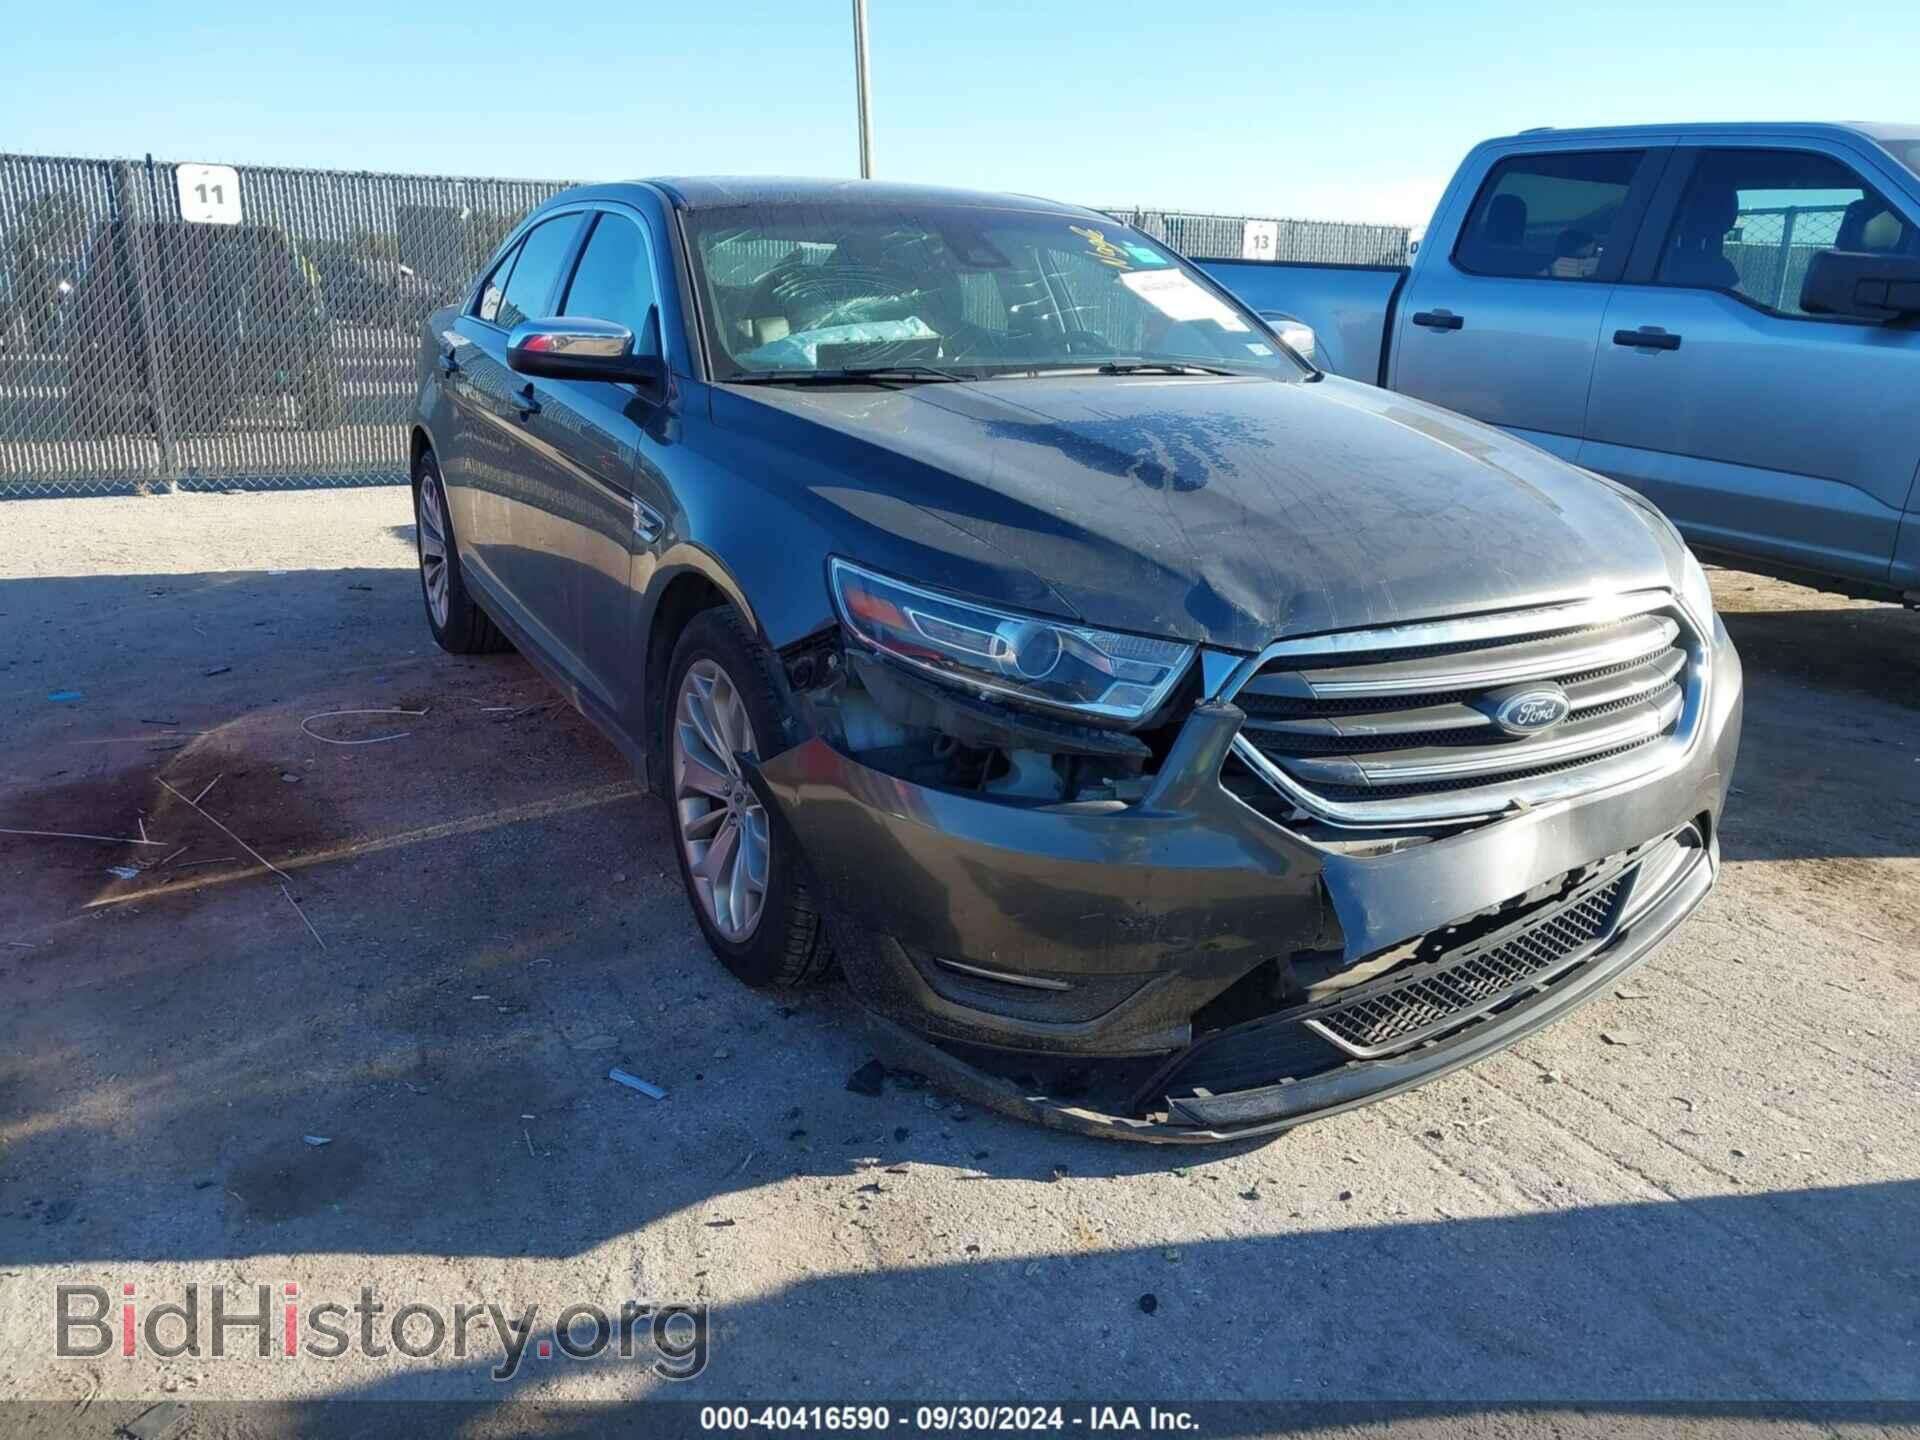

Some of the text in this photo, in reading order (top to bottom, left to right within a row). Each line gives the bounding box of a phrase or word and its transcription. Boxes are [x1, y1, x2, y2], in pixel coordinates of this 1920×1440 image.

[194, 183, 224, 205] 11
[1253, 234, 1270, 249] 13
[1517, 699, 1557, 725] Ford
